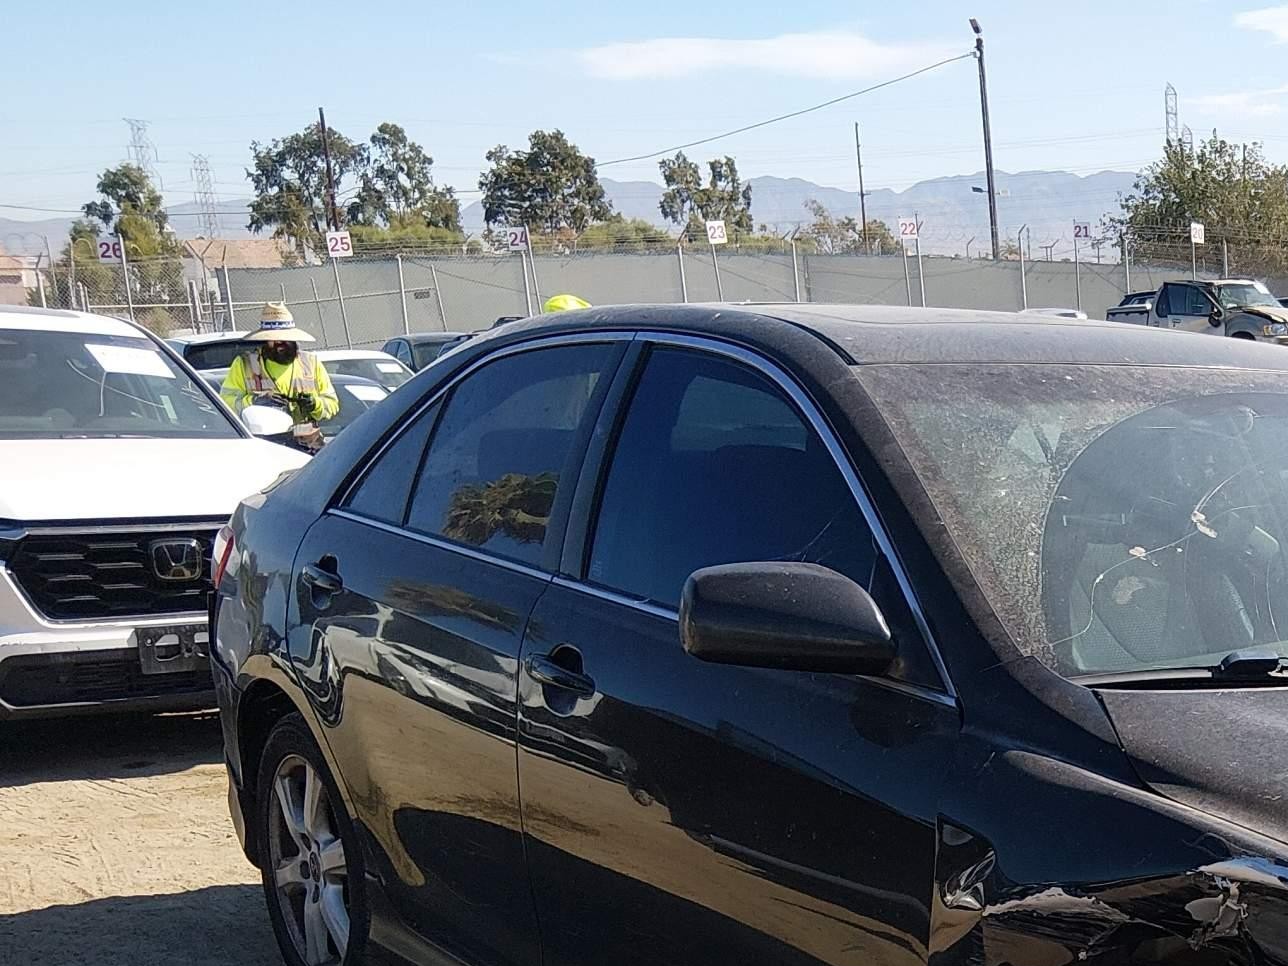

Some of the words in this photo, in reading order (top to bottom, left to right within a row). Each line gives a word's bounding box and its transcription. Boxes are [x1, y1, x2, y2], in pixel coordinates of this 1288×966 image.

[709, 227, 725, 240] 23
[900, 222, 917, 236] 22
[1074, 225, 1089, 238] 21
[328, 236, 351, 252] 25
[508, 232, 528, 247] 24
